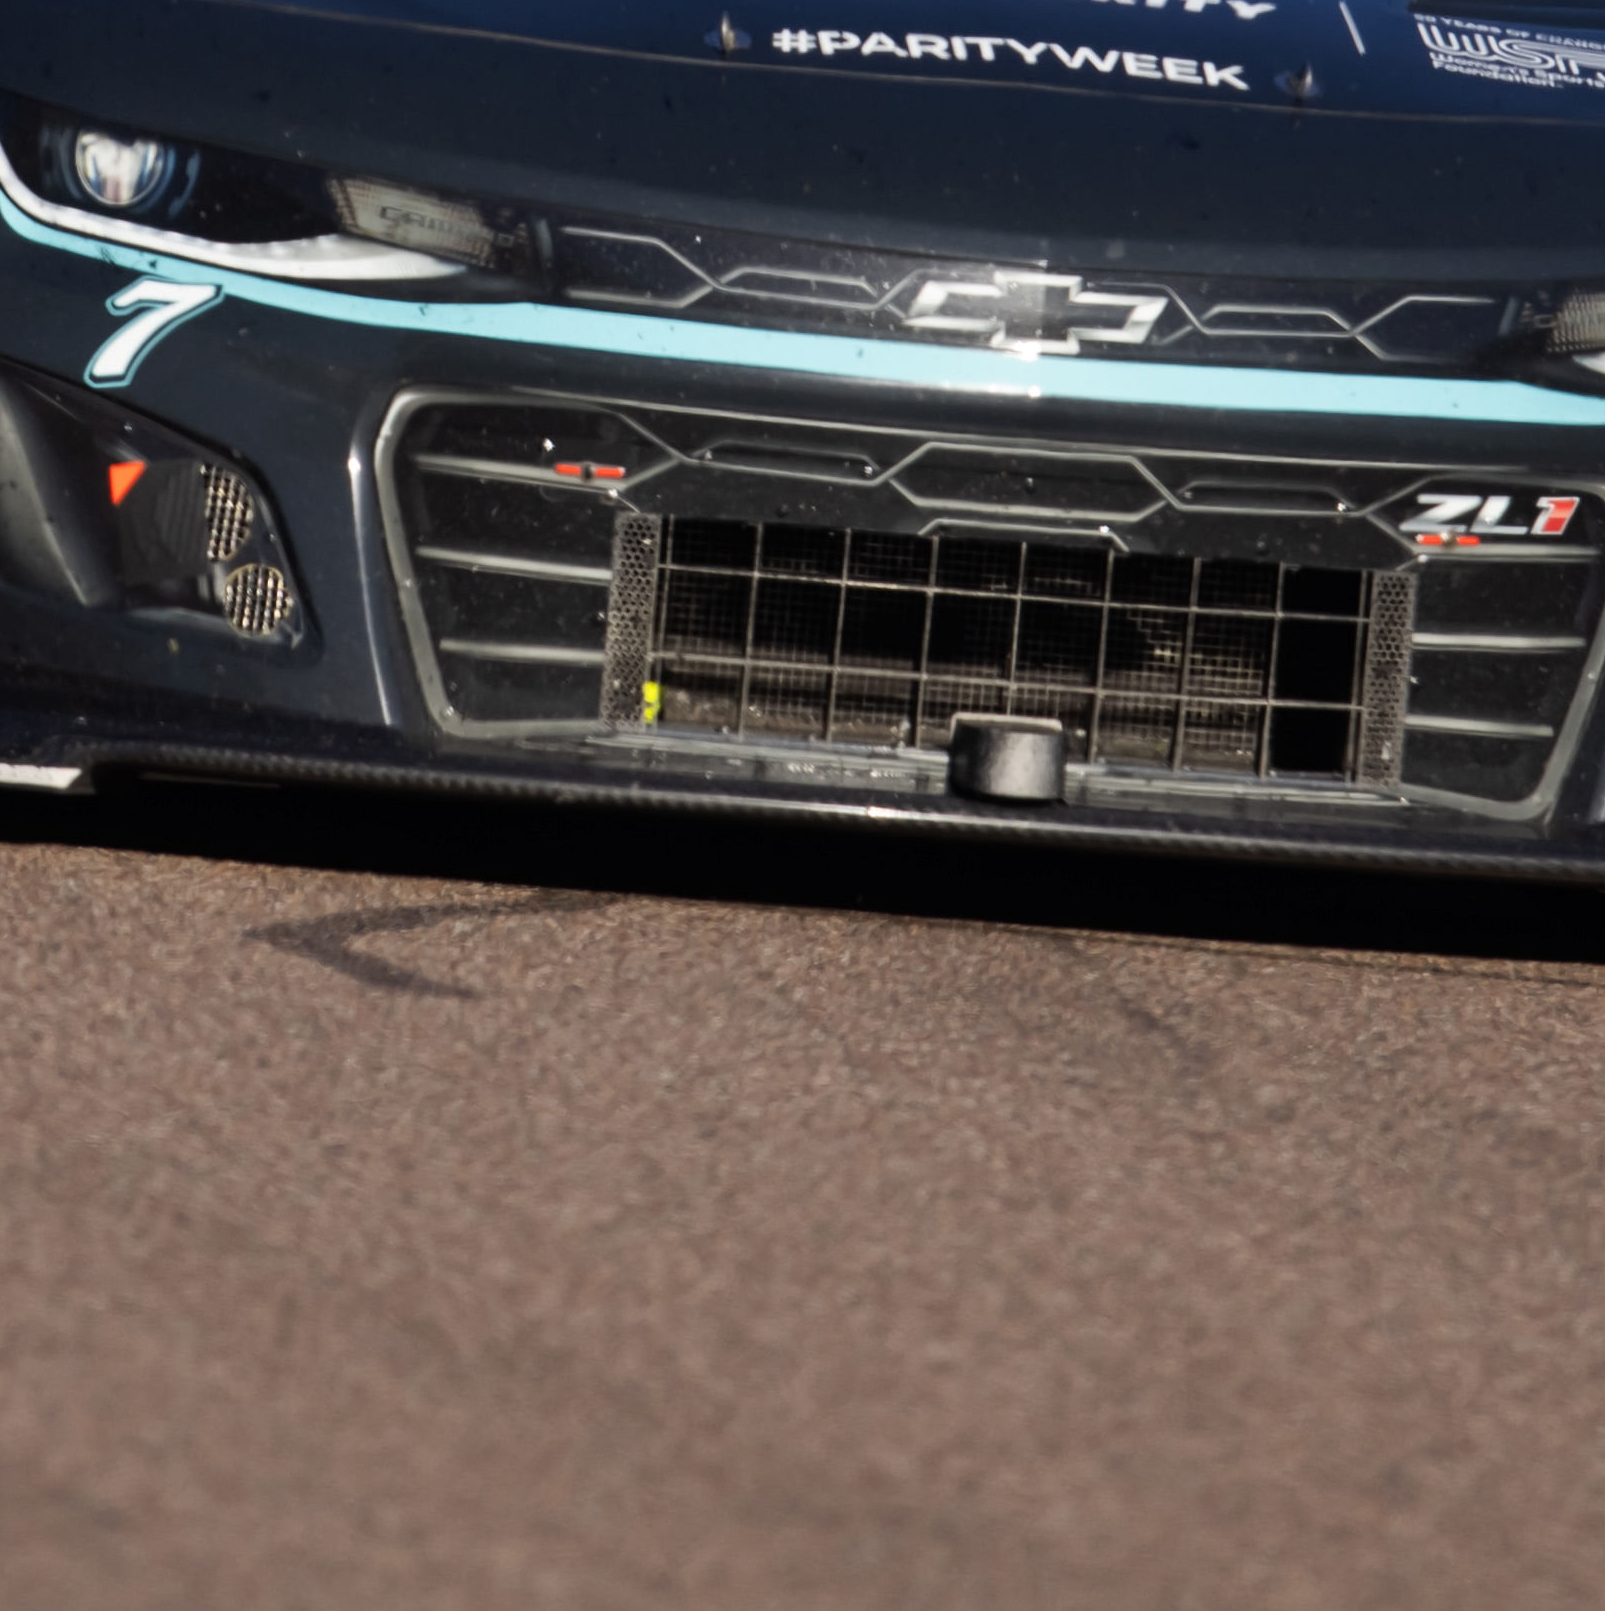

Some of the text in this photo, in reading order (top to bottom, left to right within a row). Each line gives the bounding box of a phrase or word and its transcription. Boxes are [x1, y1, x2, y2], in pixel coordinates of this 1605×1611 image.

[1440, 15, 1502, 35] YEARS
[771, 29, 1252, 91] #PARITYWEEK
[84, 275, 227, 389] 7
[1398, 493, 1581, 536] ZL1
